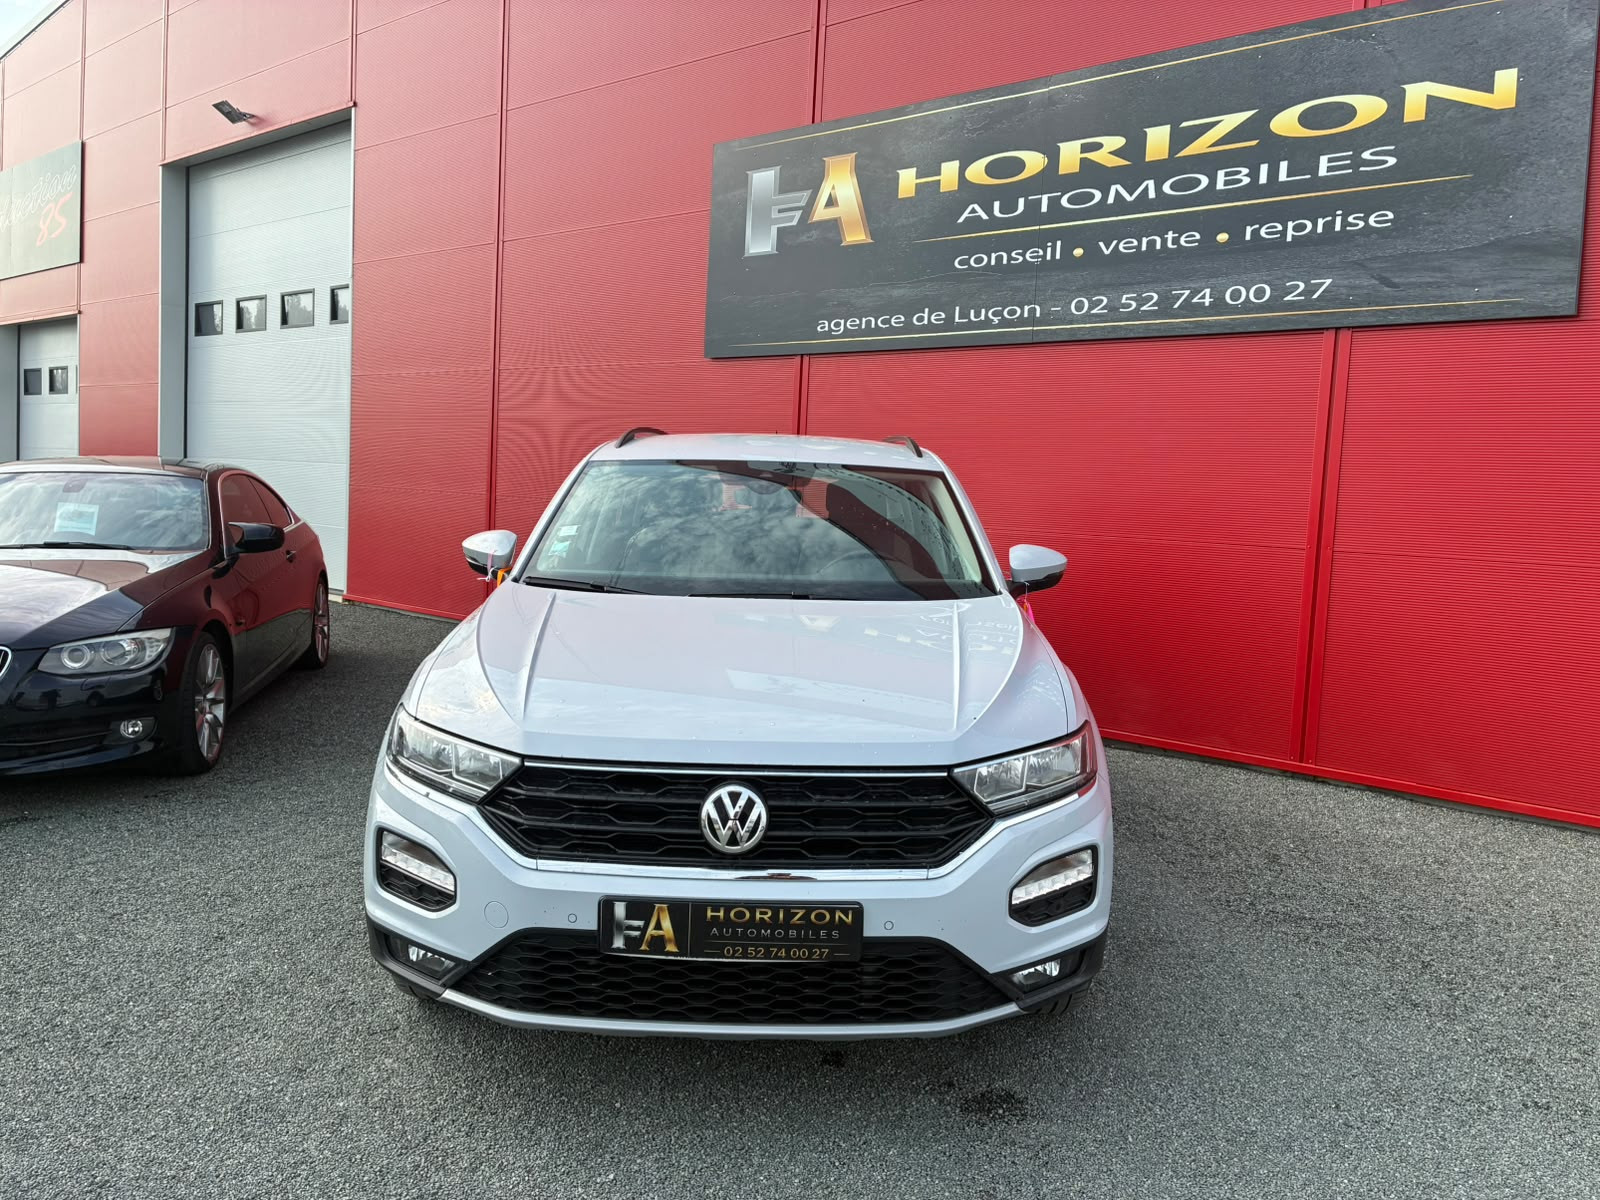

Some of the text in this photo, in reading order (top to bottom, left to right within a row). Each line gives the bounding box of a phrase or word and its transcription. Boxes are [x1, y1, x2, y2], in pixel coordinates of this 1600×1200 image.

[896, 67, 1519, 199] HORIZON
[957, 145, 1398, 224] AUTOMOBILES
[953, 209, 1395, 269] conseil vente reprise
[816, 317, 906, 336] agence
[912, 307, 946, 326] de
[954, 301, 1041, 326] Luçon
[1070, 295, 1112, 314] 02
[1120, 292, 1158, 311] 52
[1172, 288, 1215, 309] 74
[1224, 284, 1271, 305] 00
[1283, 279, 1334, 301] 27
[705, 906, 854, 925] HORIZON
[709, 927, 840, 940] AUTOMOBILES
[723, 946, 830, 960] 02 52 74 00 27
